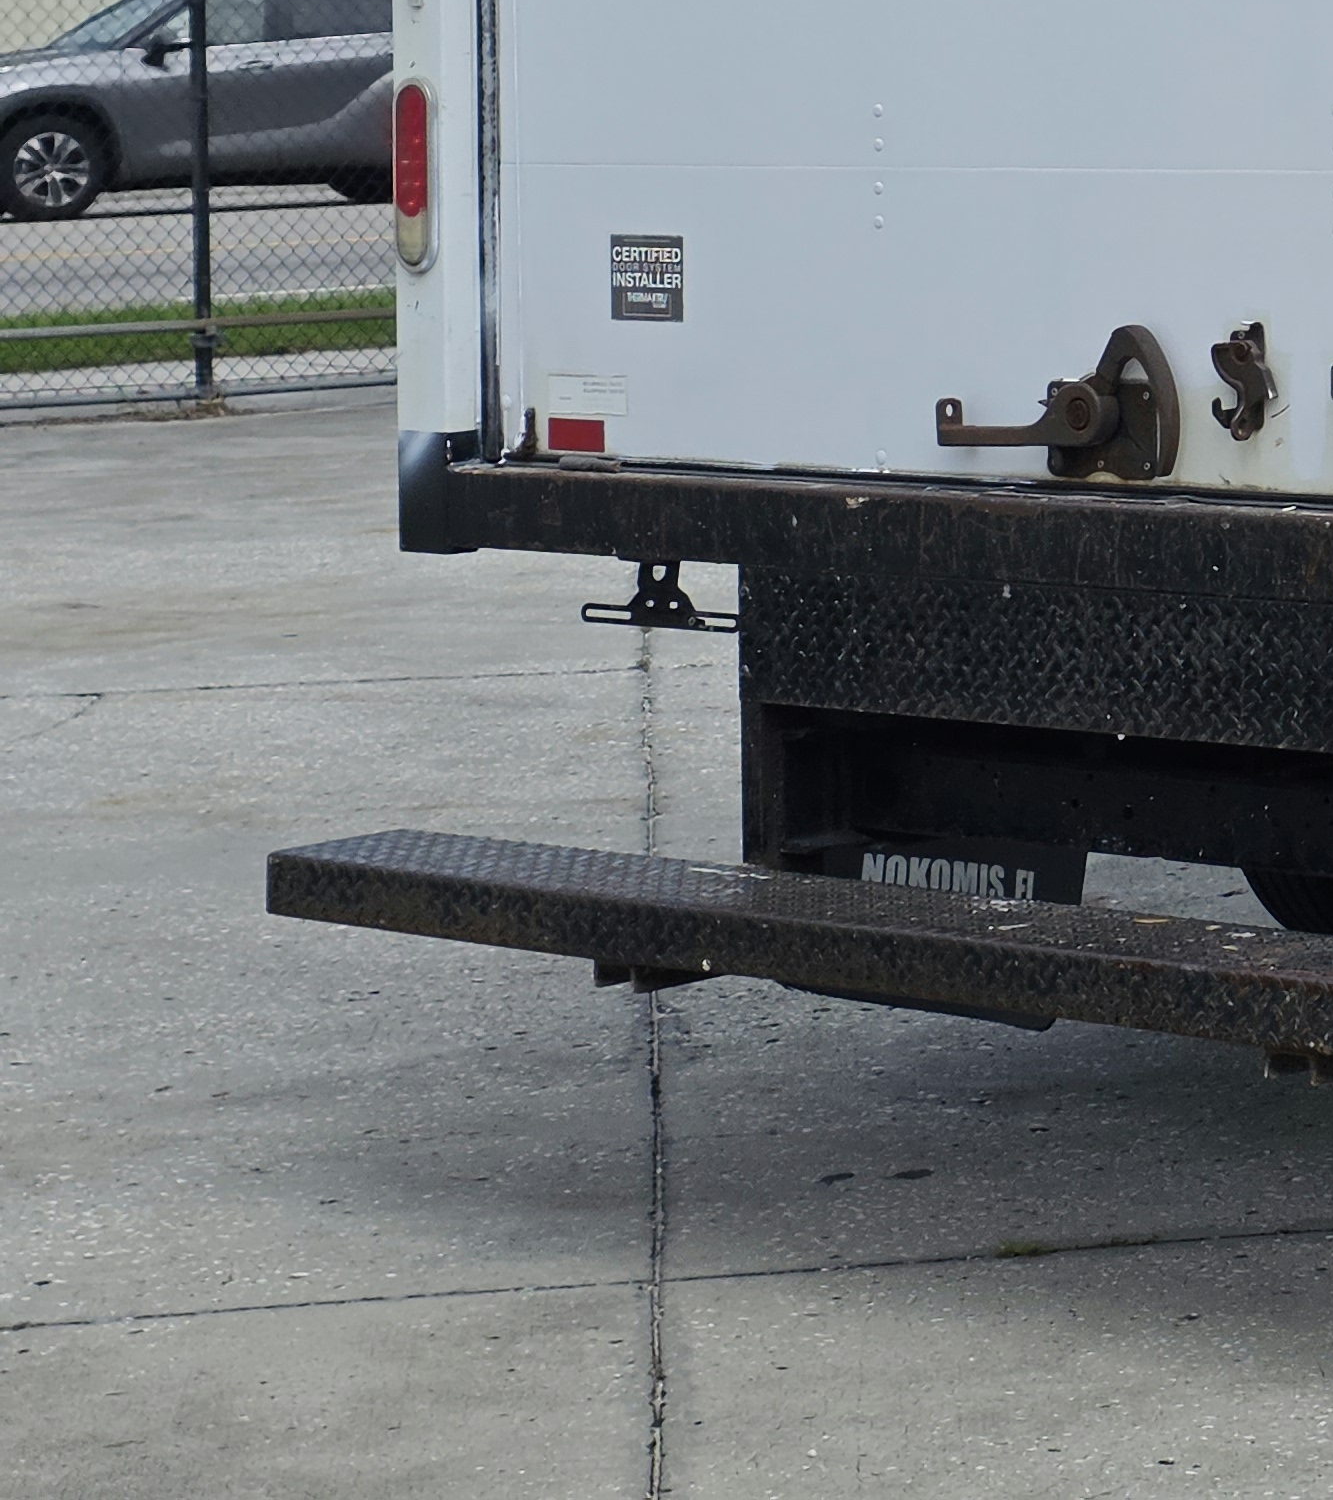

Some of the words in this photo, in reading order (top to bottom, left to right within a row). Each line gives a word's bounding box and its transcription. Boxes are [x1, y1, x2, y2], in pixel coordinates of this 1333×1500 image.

[612, 246, 681, 262] CERTIFIED
[613, 263, 639, 271] DOOR
[643, 263, 681, 272] SYSTEM
[613, 272, 682, 289] INSTALLER
